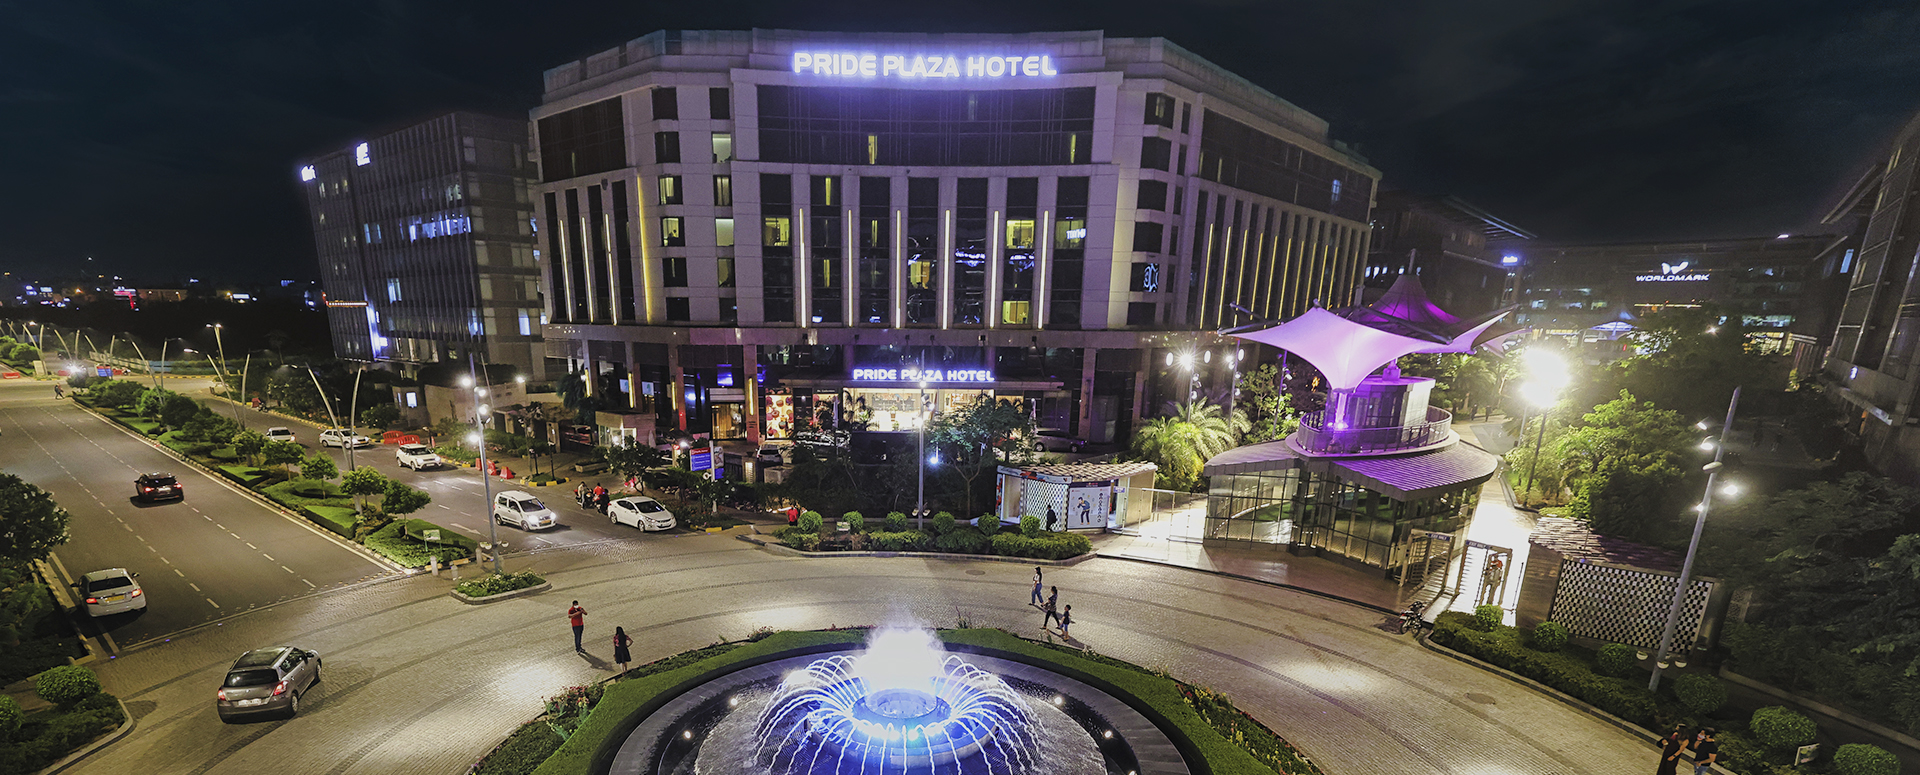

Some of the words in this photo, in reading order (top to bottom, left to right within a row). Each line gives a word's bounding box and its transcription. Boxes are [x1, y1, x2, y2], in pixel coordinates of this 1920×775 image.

[794, 53, 877, 76] PRIDE
[883, 56, 960, 77] PLAZA
[967, 55, 1057, 76] HOTEL
[853, 369, 897, 380] PRIDE
[901, 369, 943, 381] PLAZA
[947, 370, 995, 382] HOTEL
